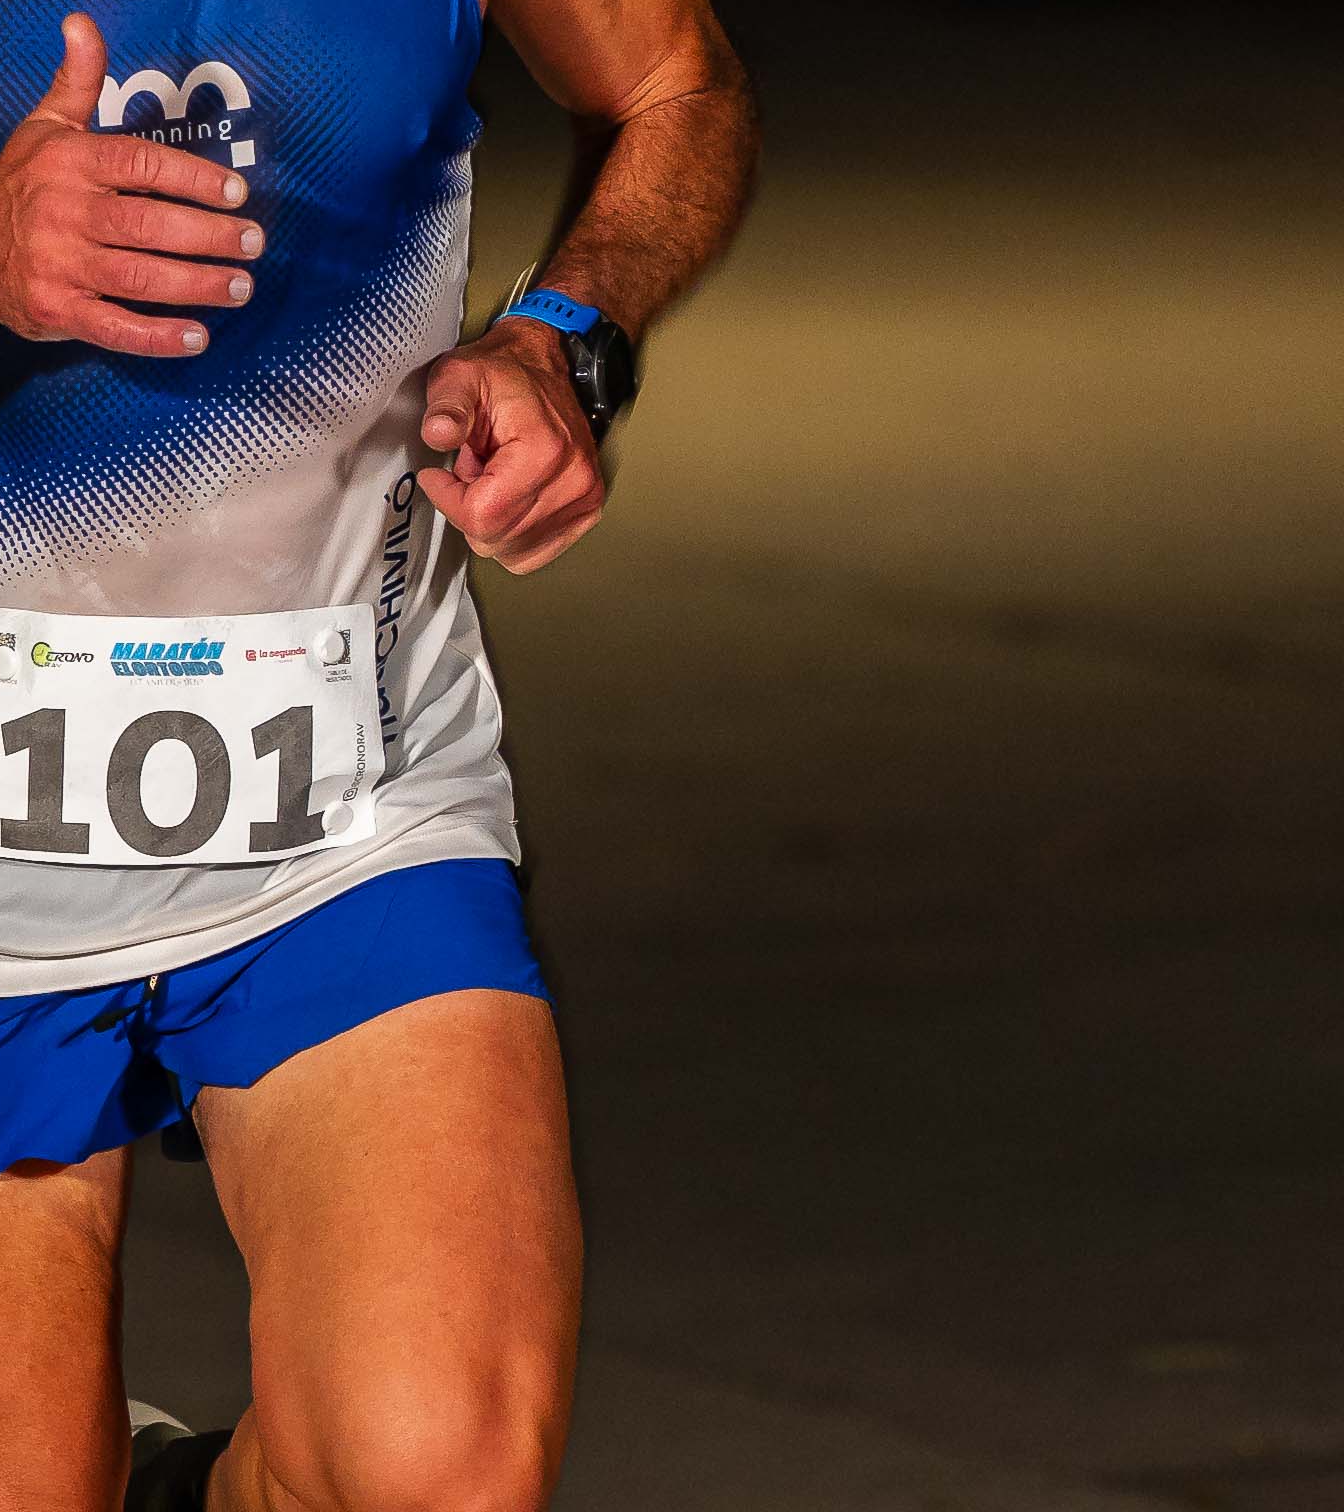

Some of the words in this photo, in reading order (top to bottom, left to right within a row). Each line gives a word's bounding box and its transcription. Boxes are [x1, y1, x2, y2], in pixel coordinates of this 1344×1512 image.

[110, 637, 225, 660] MARATÓN
[259, 649, 268, 658] la
[269, 646, 306, 659] segunda
[110, 660, 224, 676] ELORTONDO
[0, 705, 326, 857] 101
